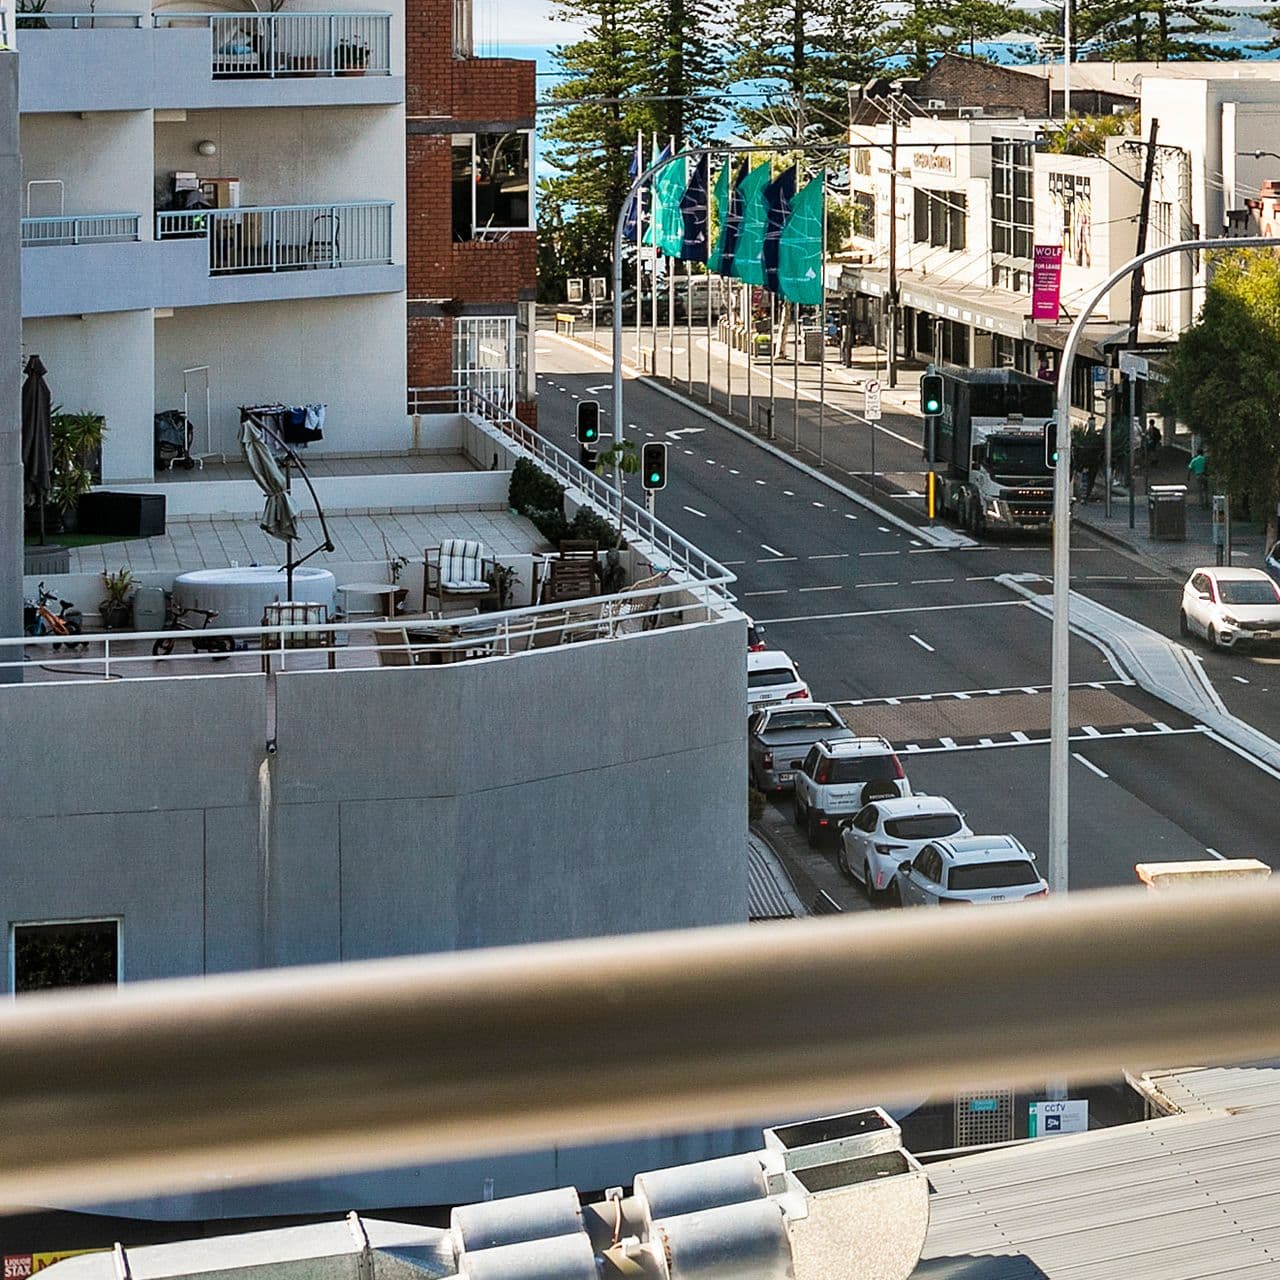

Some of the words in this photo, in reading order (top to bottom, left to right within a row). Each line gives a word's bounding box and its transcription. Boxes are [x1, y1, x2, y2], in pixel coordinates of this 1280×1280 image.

[1035, 247, 1062, 257] WOLF
[1044, 1104, 1066, 1113] CCTV
[4, 1265, 32, 1277] STAX
